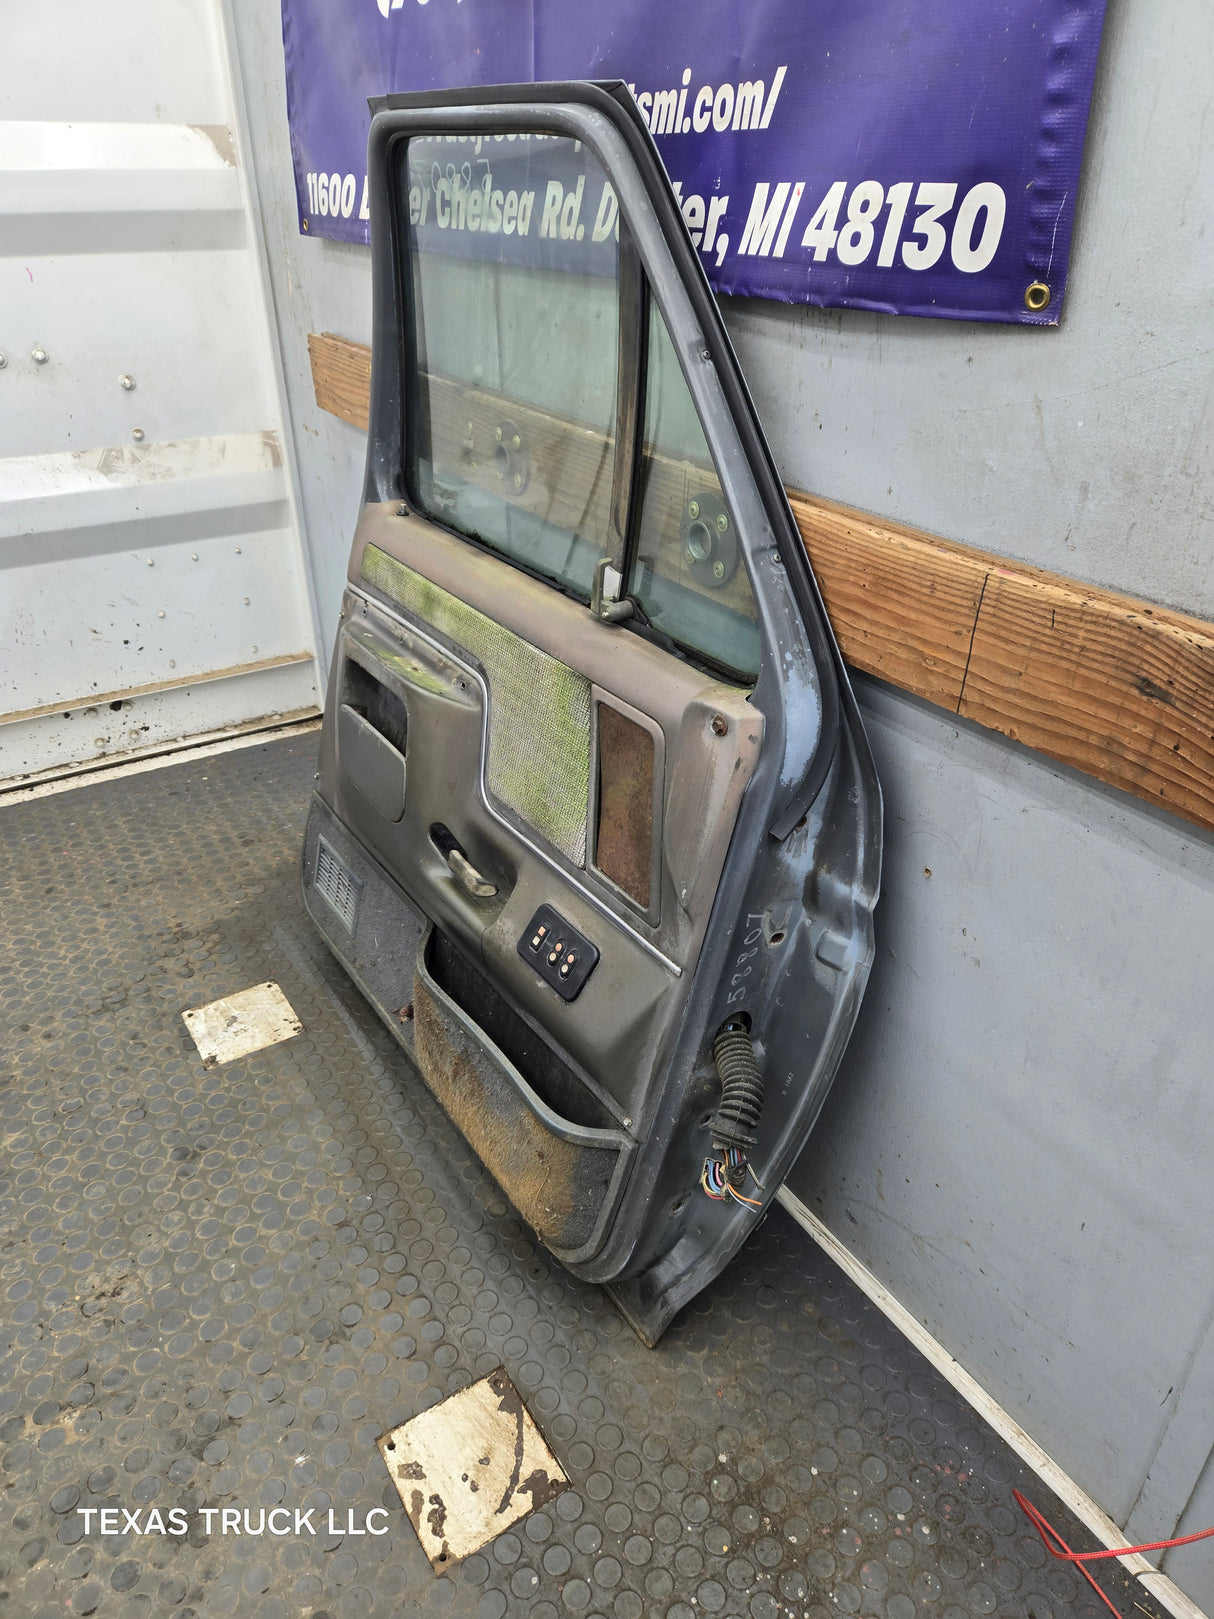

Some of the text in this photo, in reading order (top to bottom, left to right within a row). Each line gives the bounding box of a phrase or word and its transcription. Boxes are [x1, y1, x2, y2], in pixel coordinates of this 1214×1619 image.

[306, 172, 356, 219] 11600
[436, 173, 535, 236] Chelsea
[538, 175, 585, 242] Rd.
[738, 182, 805, 258] MI
[801, 181, 1006, 273] 48130
